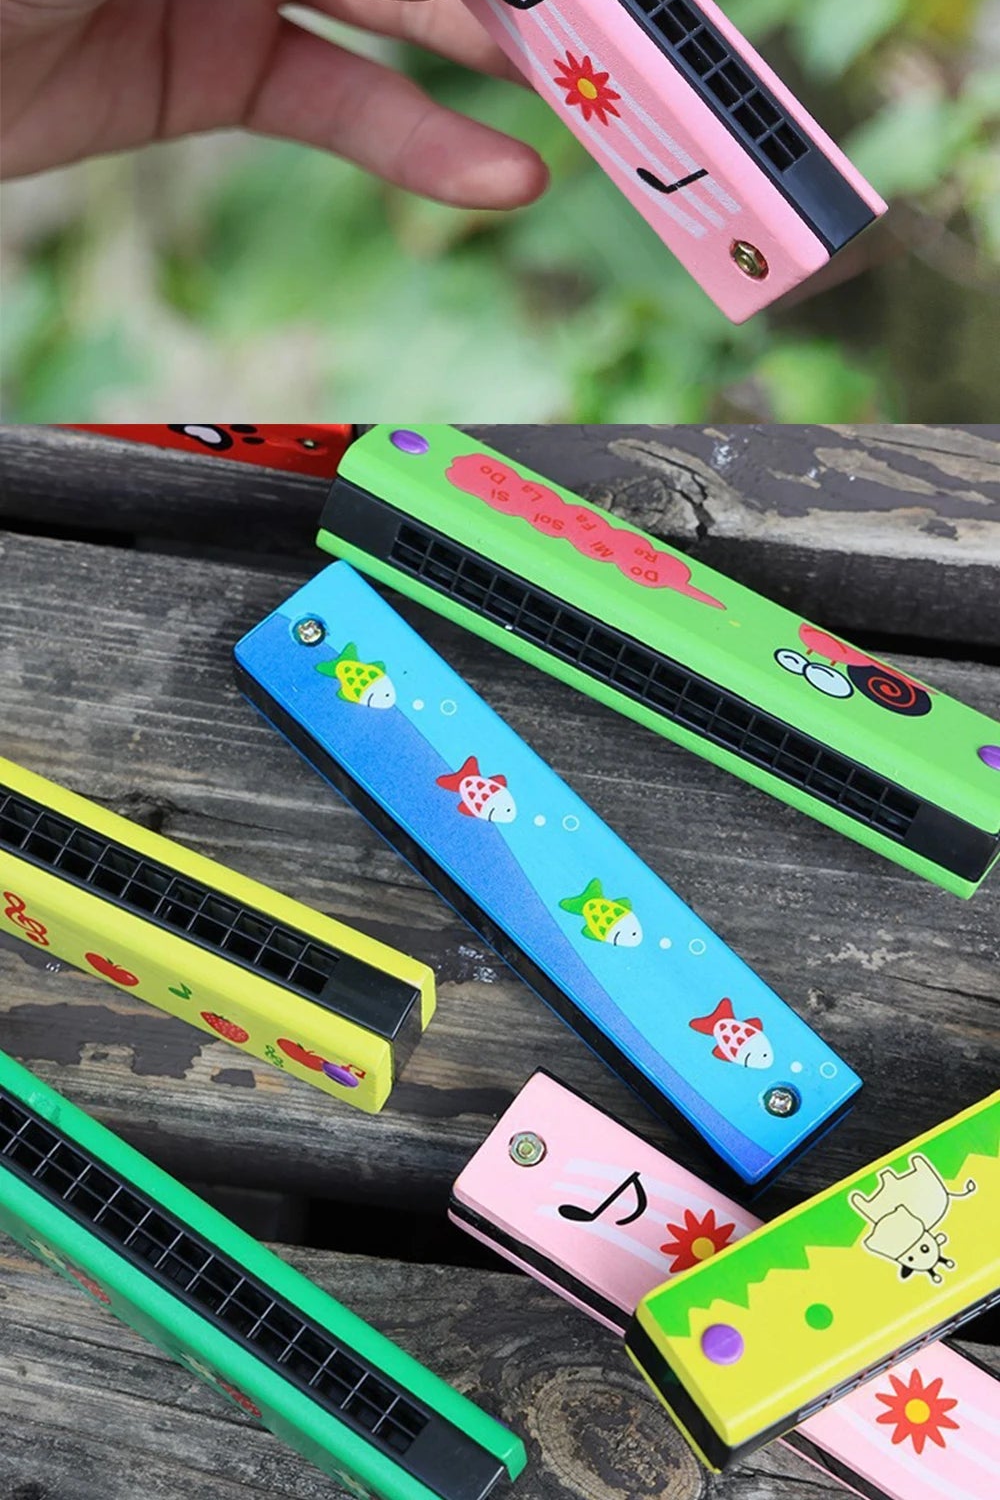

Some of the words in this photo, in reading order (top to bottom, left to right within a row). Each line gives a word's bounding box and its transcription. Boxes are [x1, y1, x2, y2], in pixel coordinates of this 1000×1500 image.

[480, 465, 506, 485] Do
[491, 490, 510, 502] Si
[522, 484, 543, 502] La
[534, 513, 564, 531] Sol
[576, 514, 596, 531] Fa
[590, 542, 614, 558] Mi
[630, 566, 660, 583] Do
